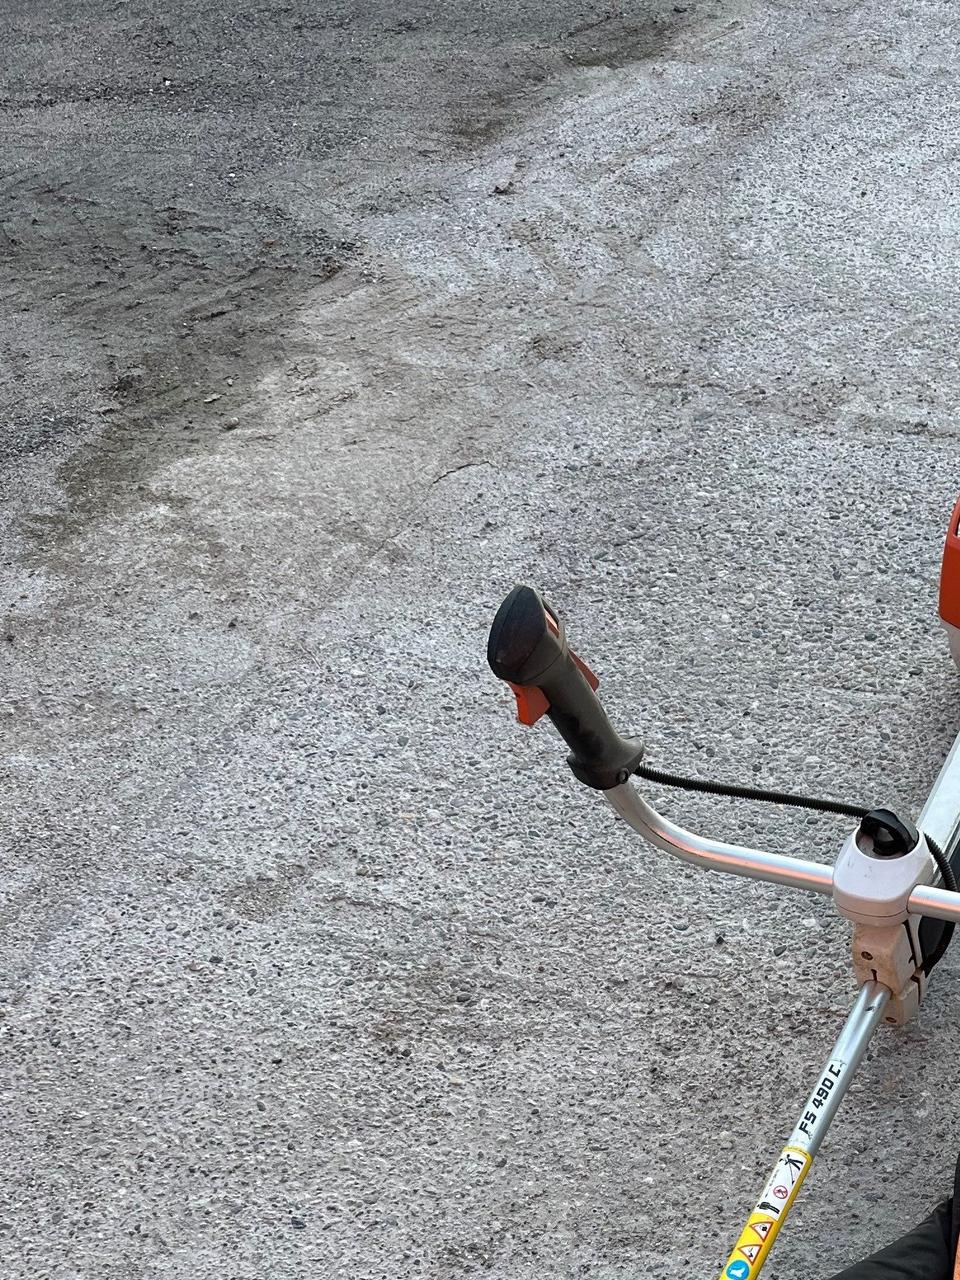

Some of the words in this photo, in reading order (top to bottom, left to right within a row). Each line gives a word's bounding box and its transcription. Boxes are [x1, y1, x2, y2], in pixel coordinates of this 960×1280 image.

[799, 1111, 817, 1135] FS
[812, 1077, 834, 1109] 490
[828, 1064, 841, 1078] C
